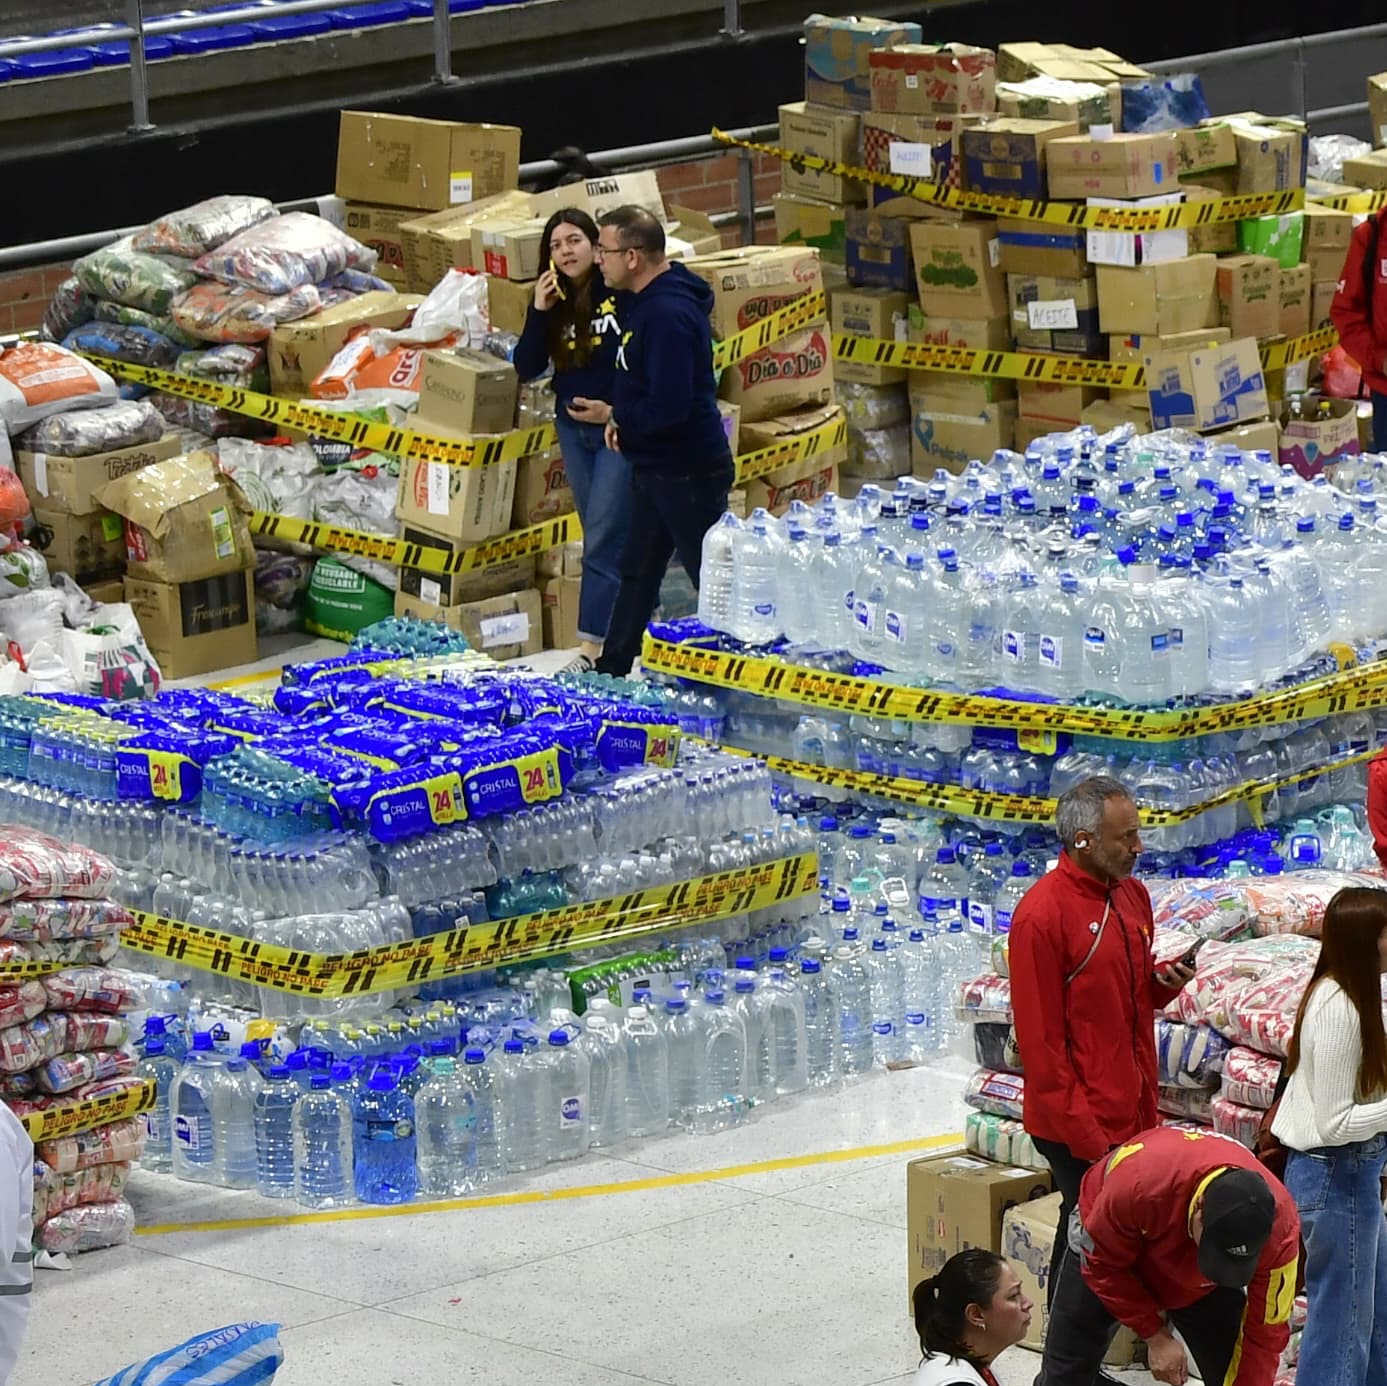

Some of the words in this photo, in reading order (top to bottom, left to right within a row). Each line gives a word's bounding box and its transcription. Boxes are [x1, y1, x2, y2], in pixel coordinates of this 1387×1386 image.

[609, 736, 642, 752] CRISTAL
[647, 736, 667, 758] 24
[120, 764, 149, 778] CRISTAL
[152, 763, 168, 785] 24
[479, 776, 517, 795] CRISTAL
[523, 767, 545, 793] 24
[391, 799, 426, 817] CRISTAL
[432, 789, 451, 811] 24
[241, 961, 279, 978] PELIGRO
[43, 1111, 84, 1131] PELIGRO
[86, 1109, 102, 1121] NO
[103, 1101, 128, 1118] PASE
